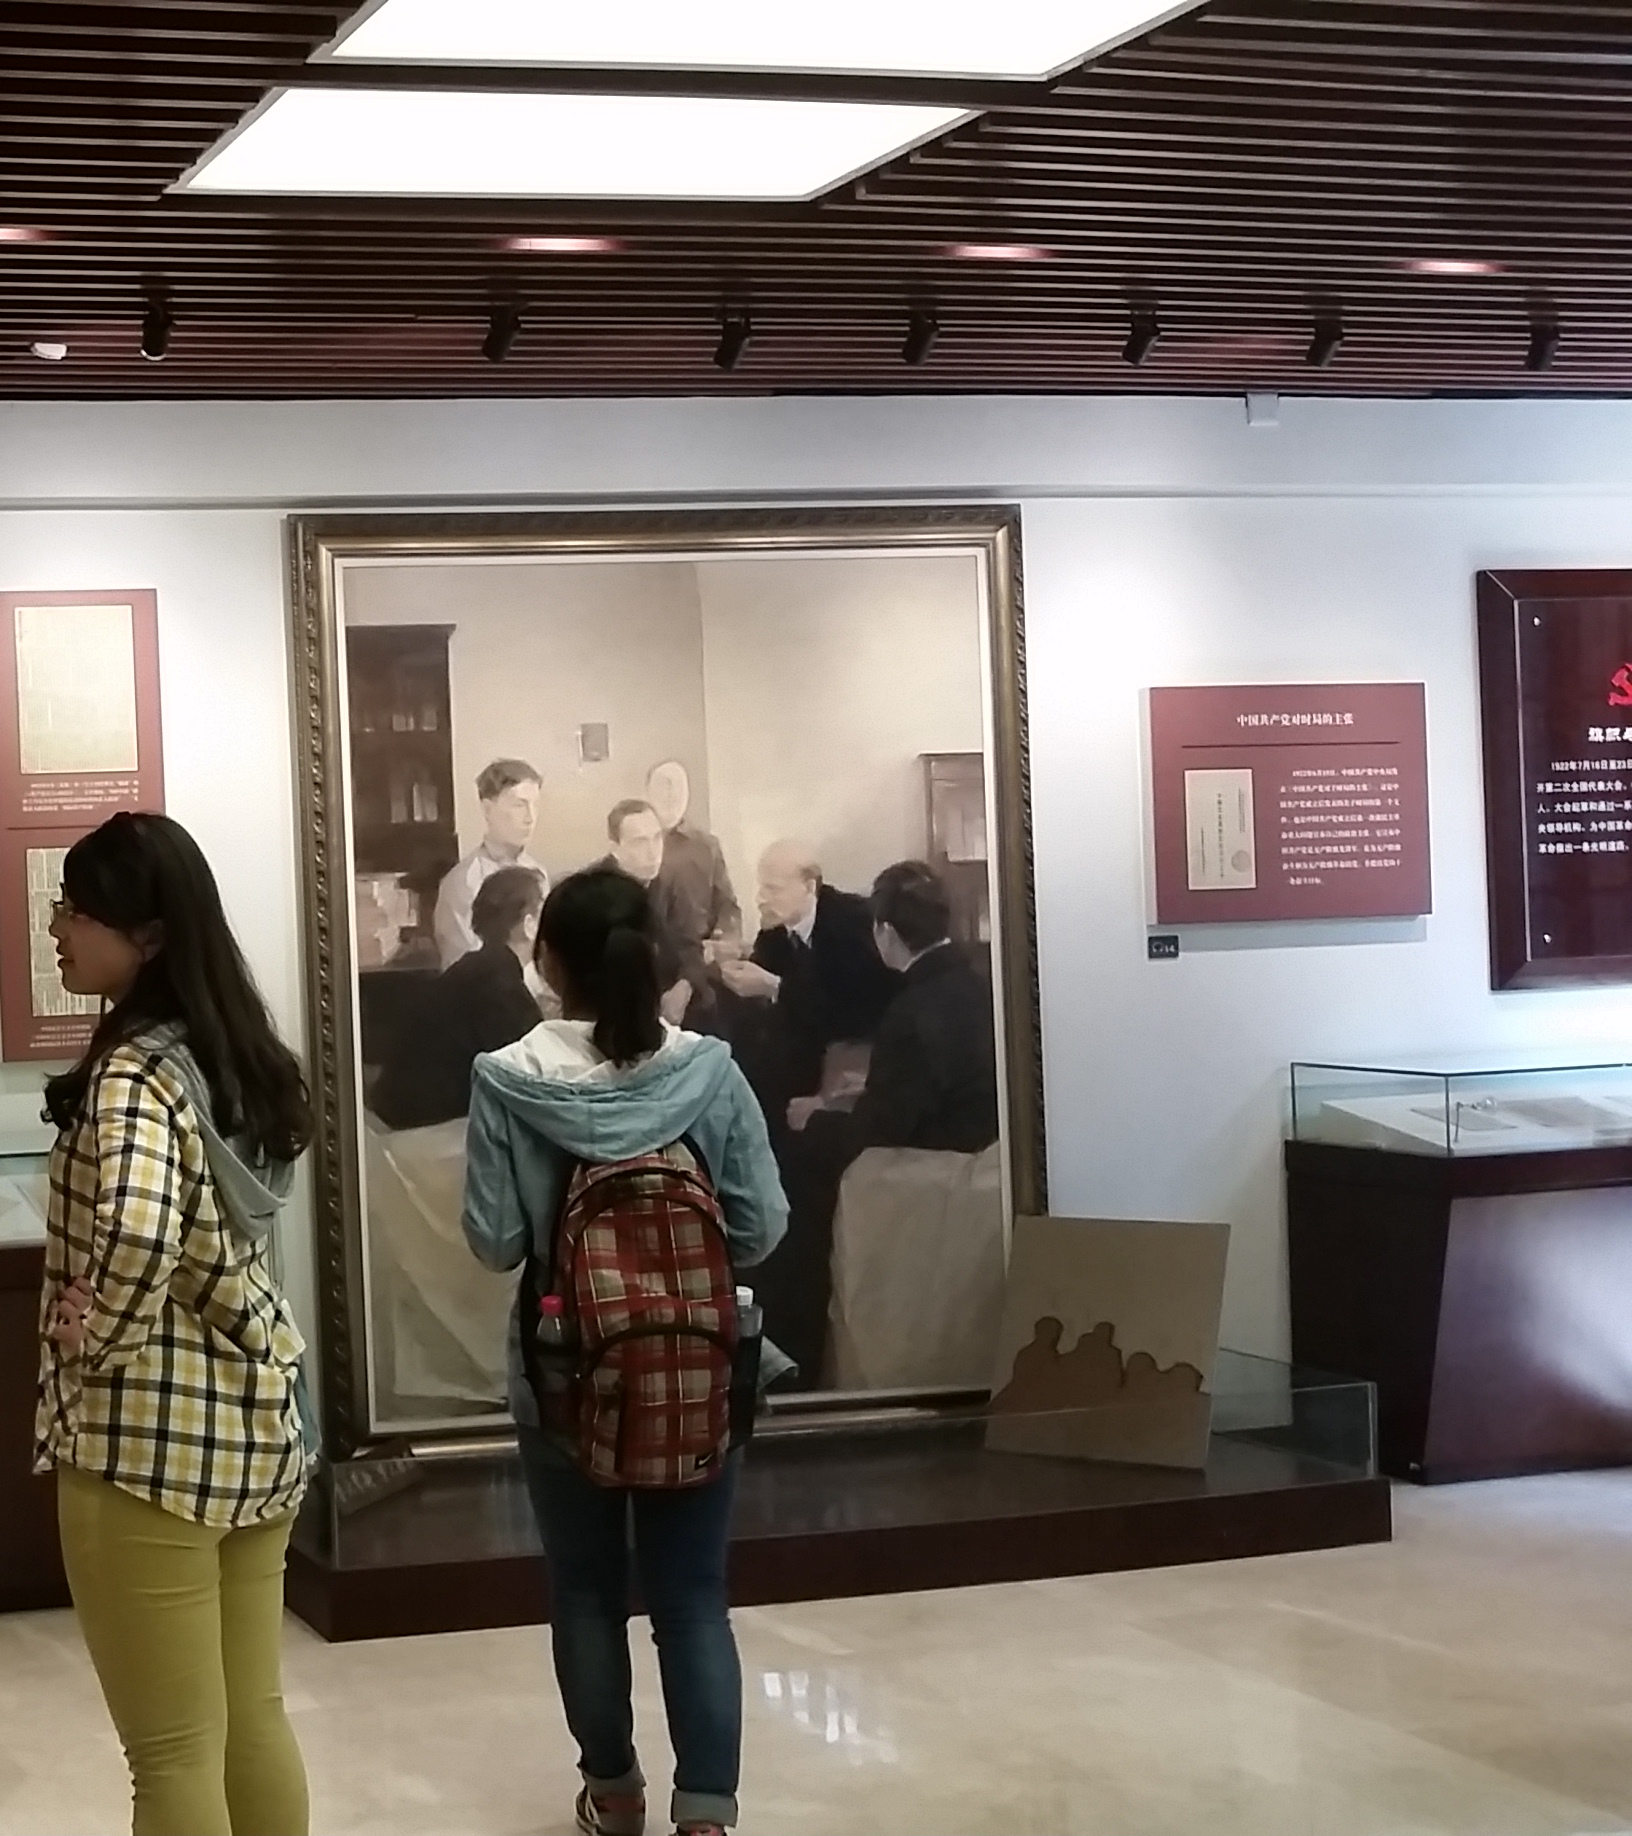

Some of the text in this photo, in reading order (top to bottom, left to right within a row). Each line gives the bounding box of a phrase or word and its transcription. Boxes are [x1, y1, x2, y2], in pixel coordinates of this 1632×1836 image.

[1236, 712, 1354, 727] 中国共产党对时局的主张
